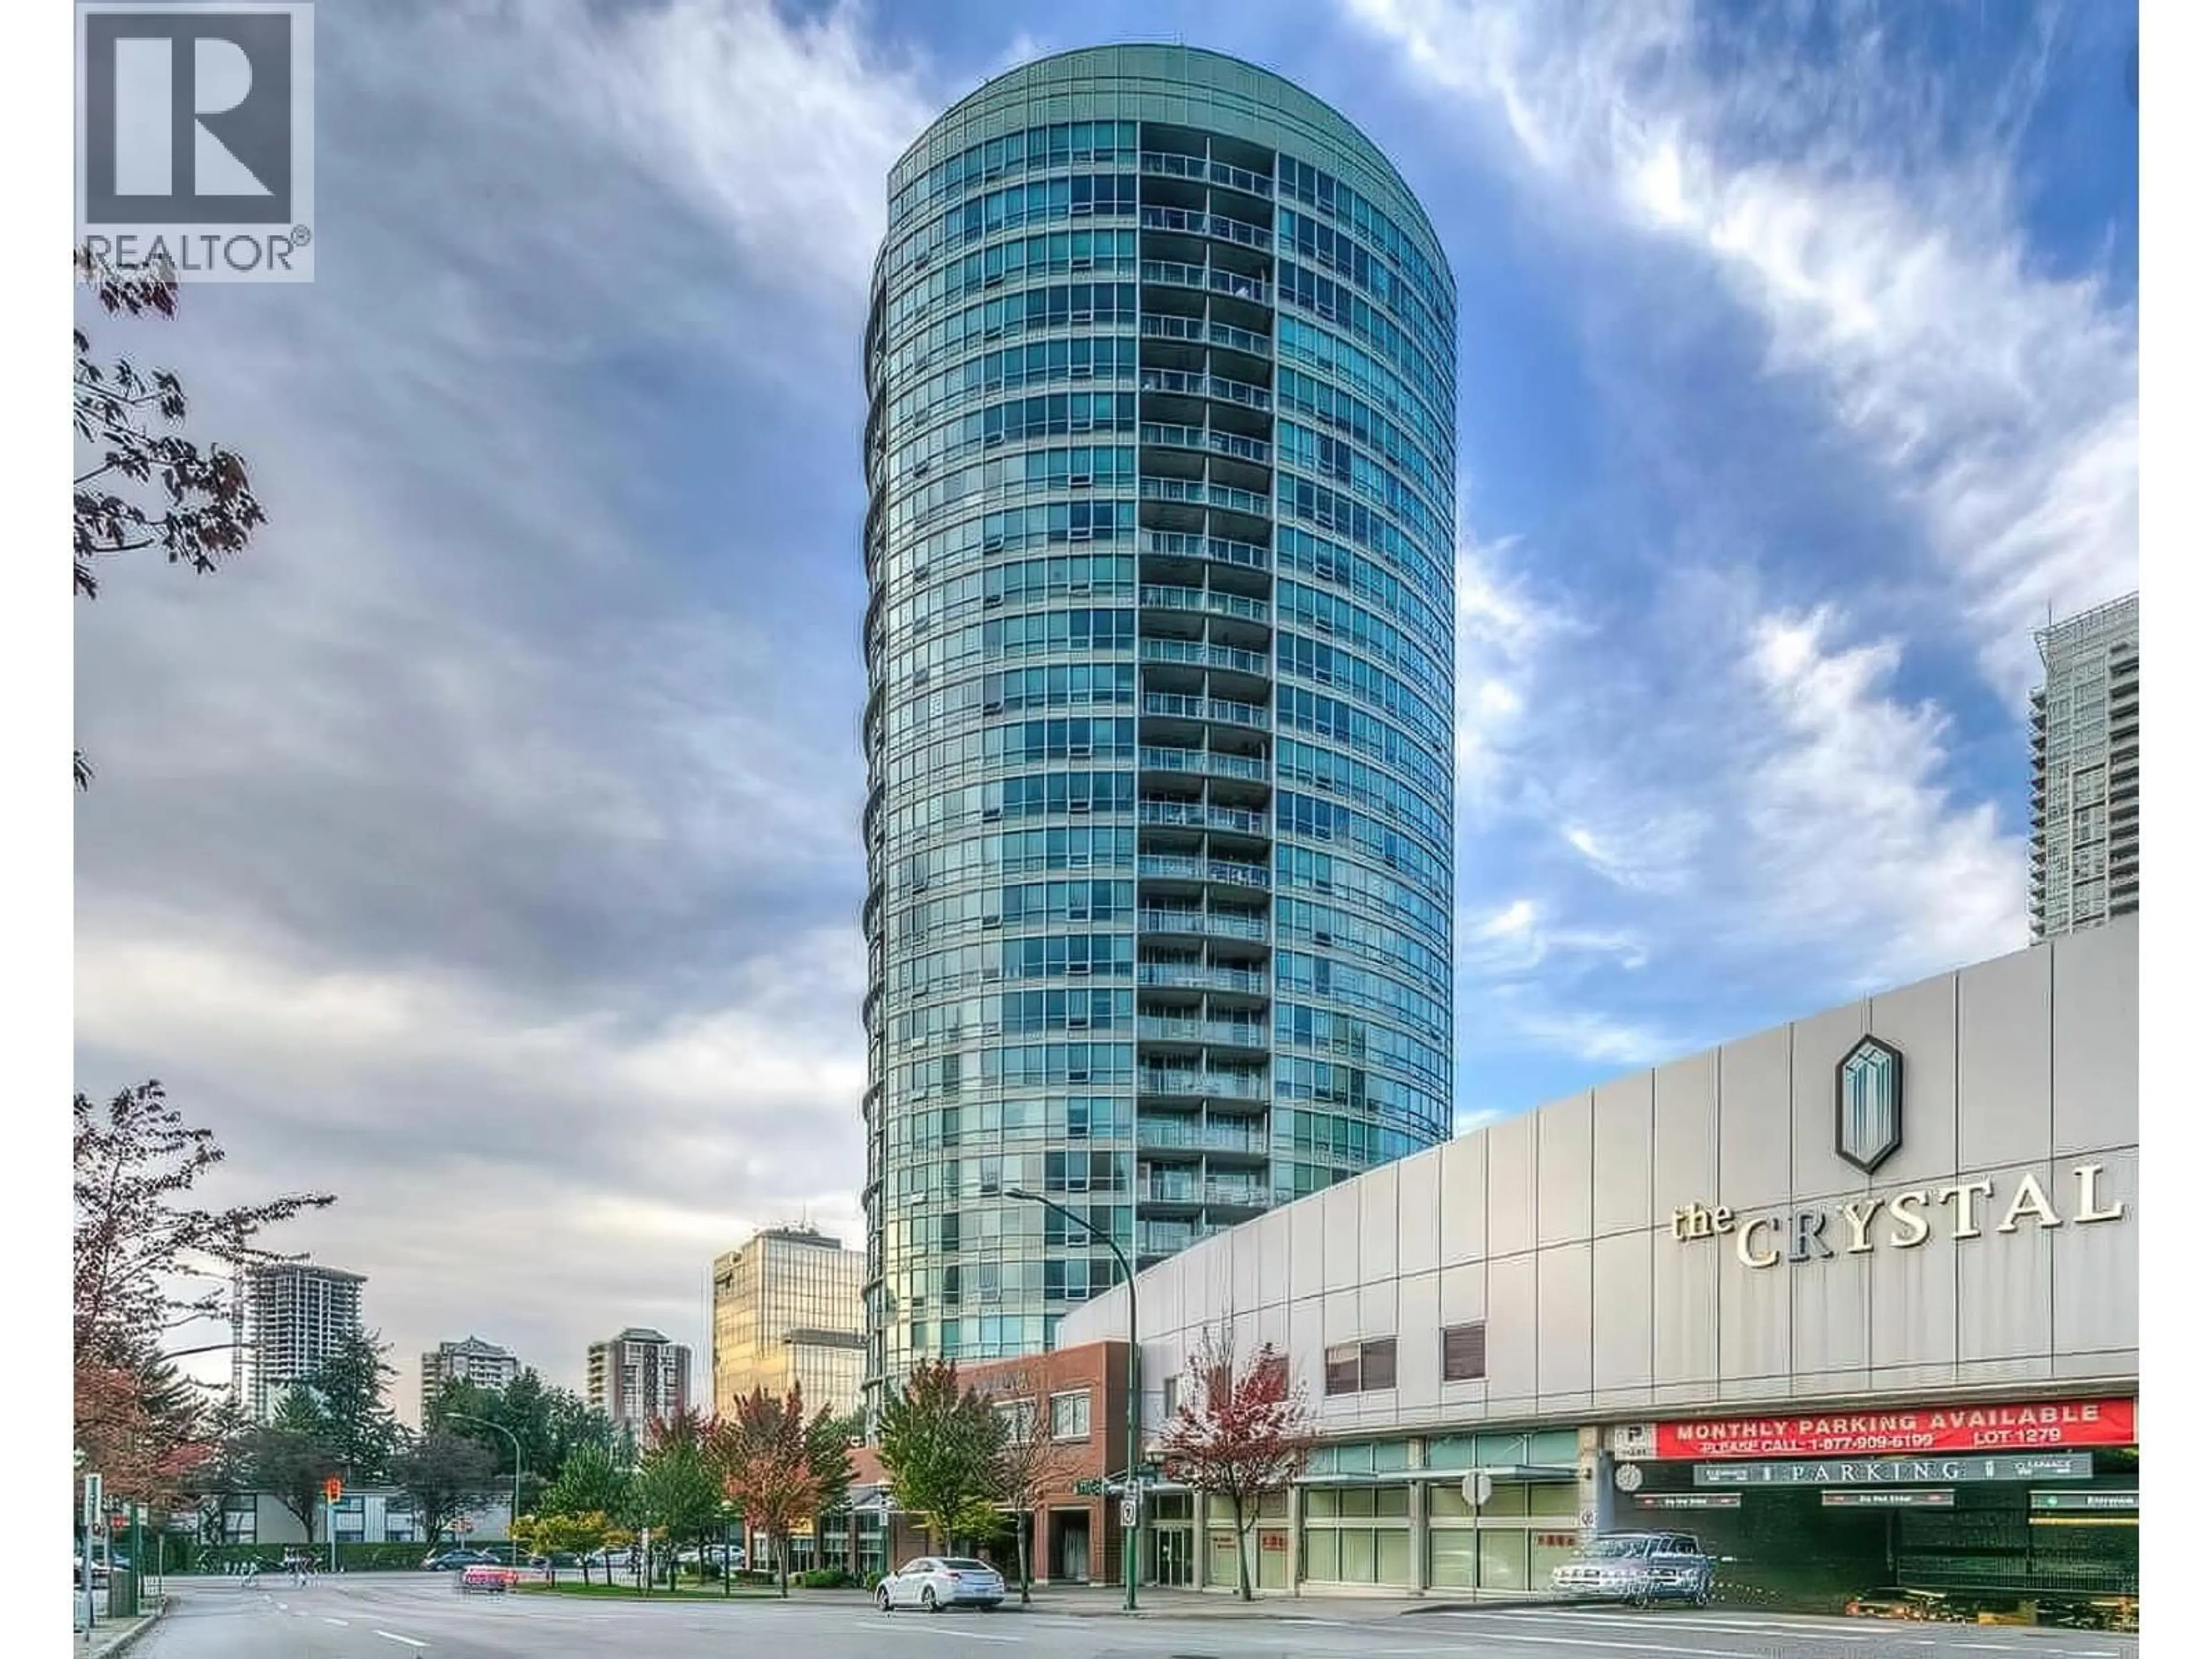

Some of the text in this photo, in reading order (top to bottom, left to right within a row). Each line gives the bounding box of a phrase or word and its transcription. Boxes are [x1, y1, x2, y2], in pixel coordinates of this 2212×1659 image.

[1670, 1164, 2126, 1268] the CRYSTAL
[1677, 1404, 2100, 1440] MONTHLY PARKING AVAILABLE
[1761, 1438, 1797, 1451] CALL
[1974, 1431, 2009, 1446] LOT
[2015, 1427, 2061, 1444] 1279
[1792, 1462, 1960, 1481] PARKING
